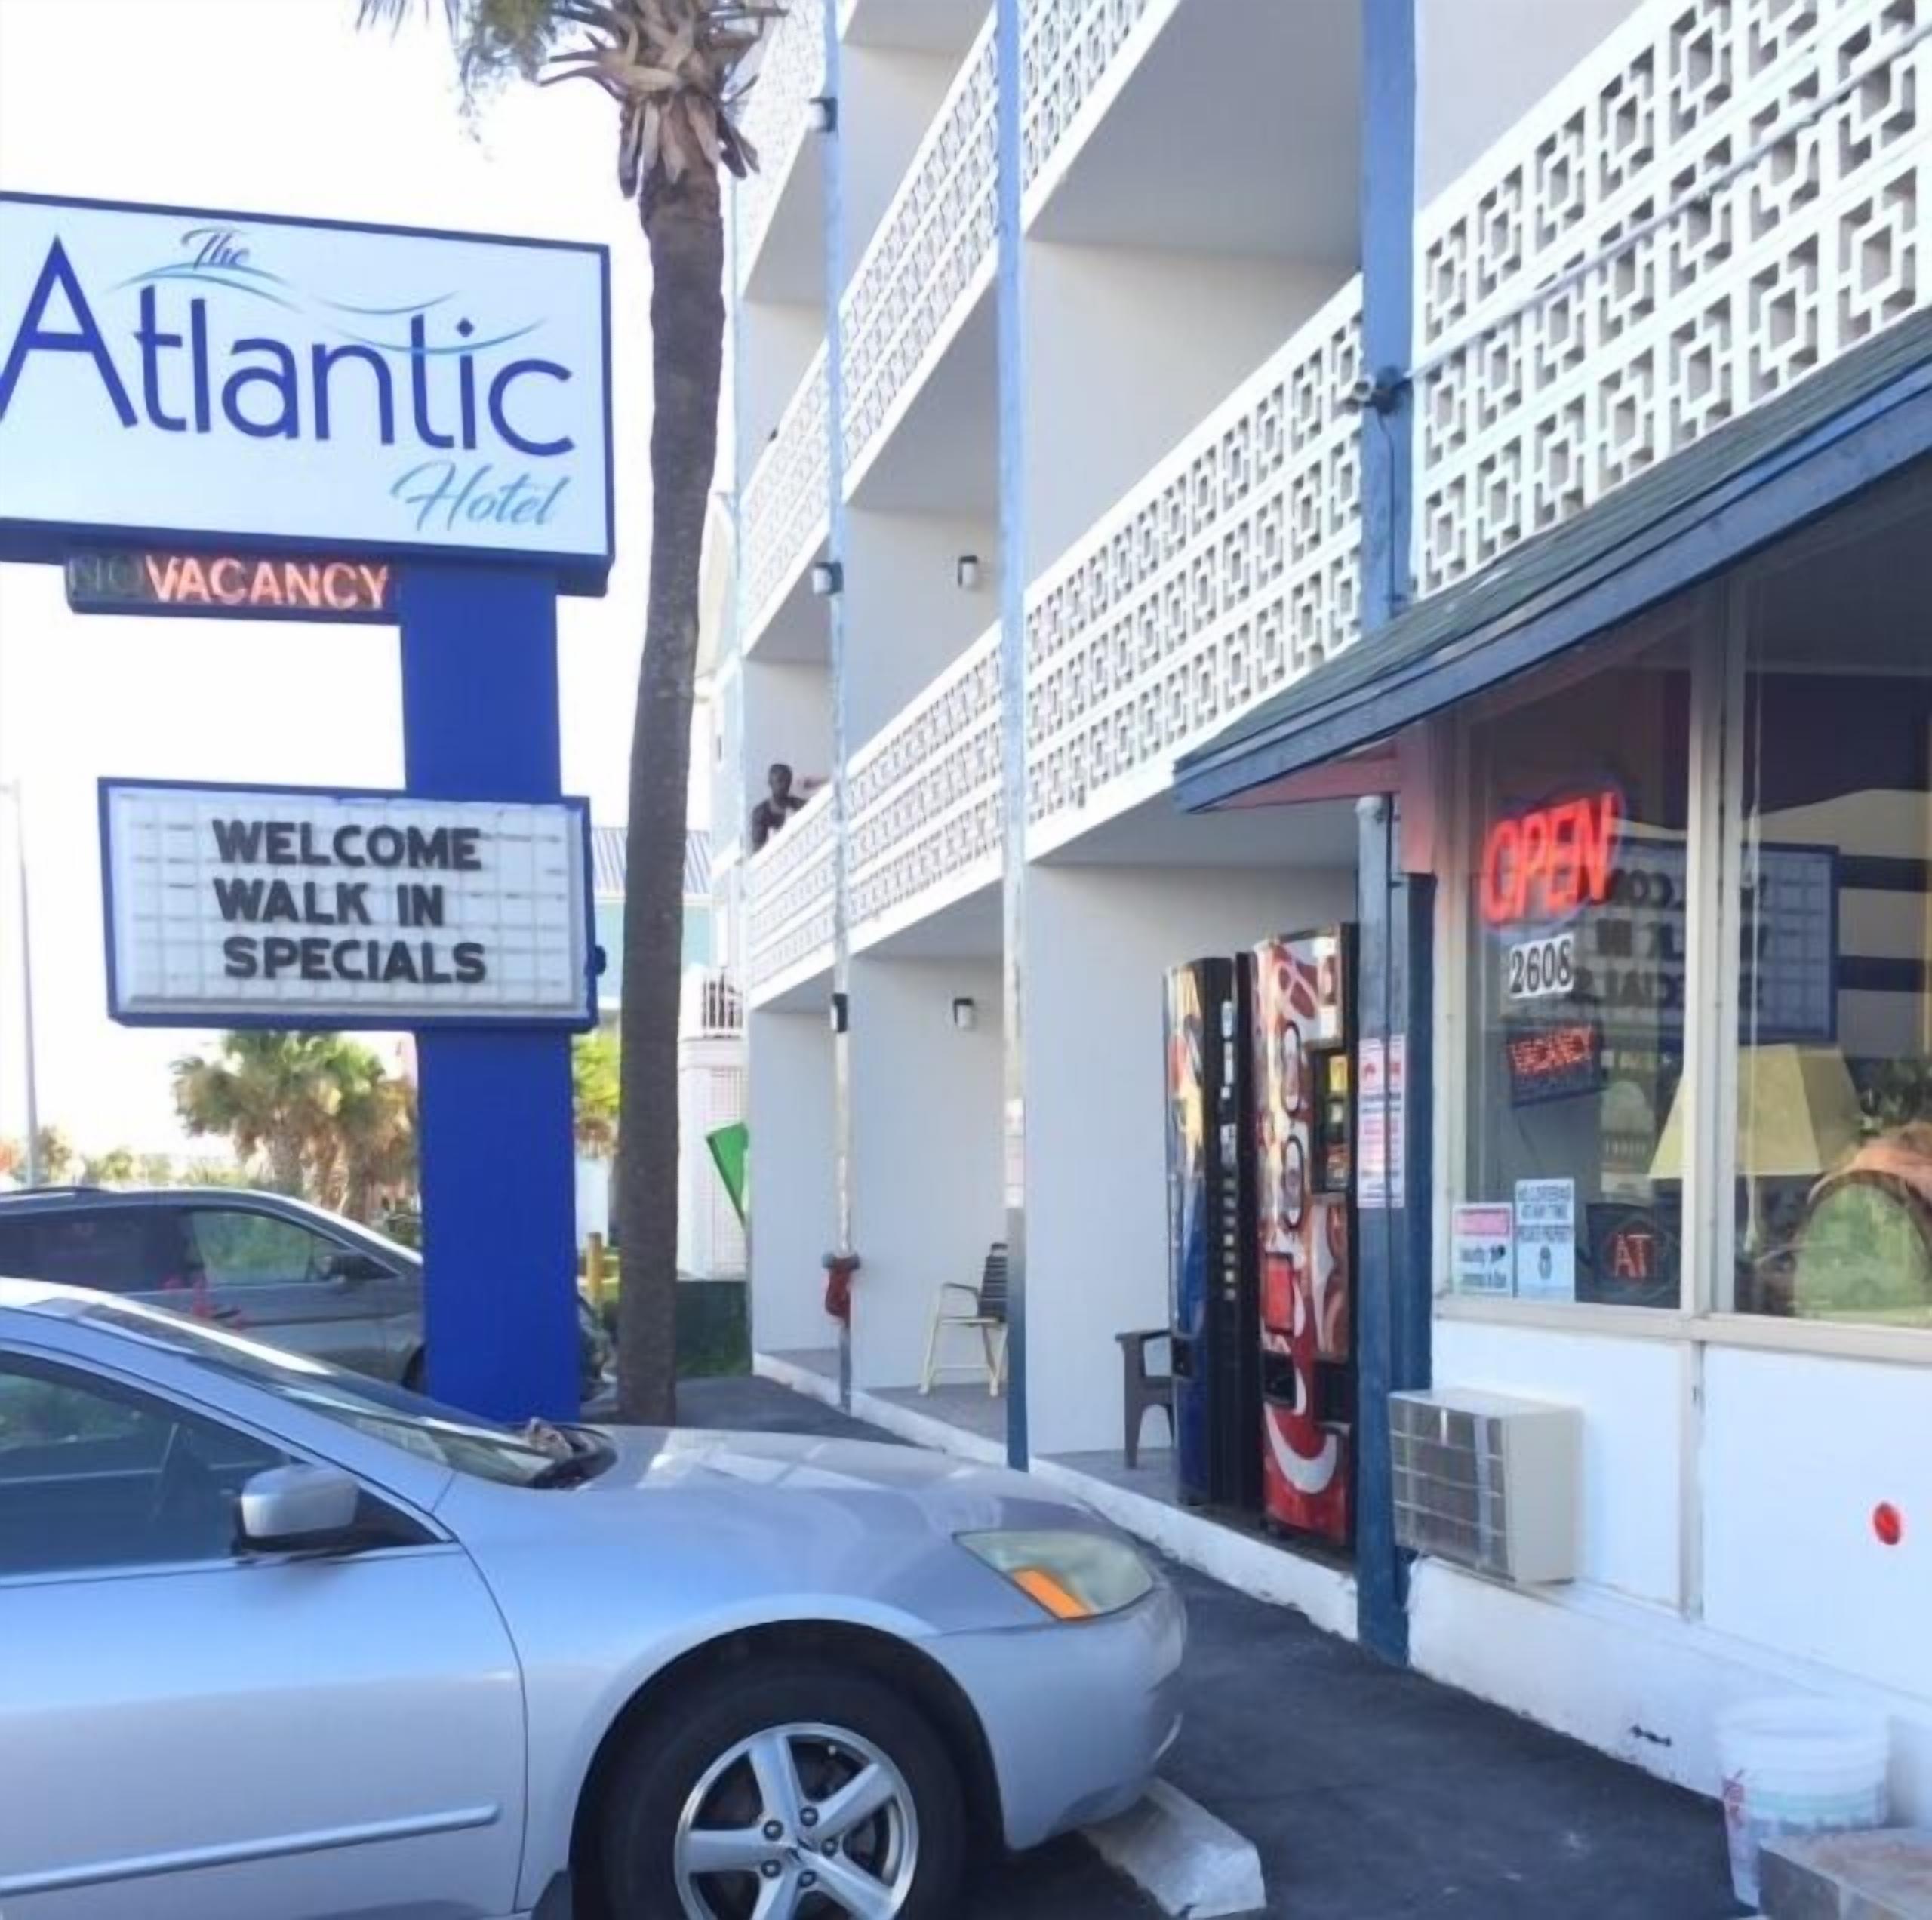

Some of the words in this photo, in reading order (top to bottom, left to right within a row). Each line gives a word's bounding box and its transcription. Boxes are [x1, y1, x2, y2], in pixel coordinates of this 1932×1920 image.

[181, 226, 251, 269] The
[0, 232, 576, 456] Atlantic
[389, 460, 571, 531] Hotel
[146, 555, 389, 610] VACANCY
[212, 818, 483, 870] WELCOME
[1483, 790, 1620, 923] OPEN
[214, 878, 372, 925] WALK
[398, 884, 444, 927] IN
[223, 936, 487, 983] SPECIALS
[1511, 938, 1572, 994] 2608
